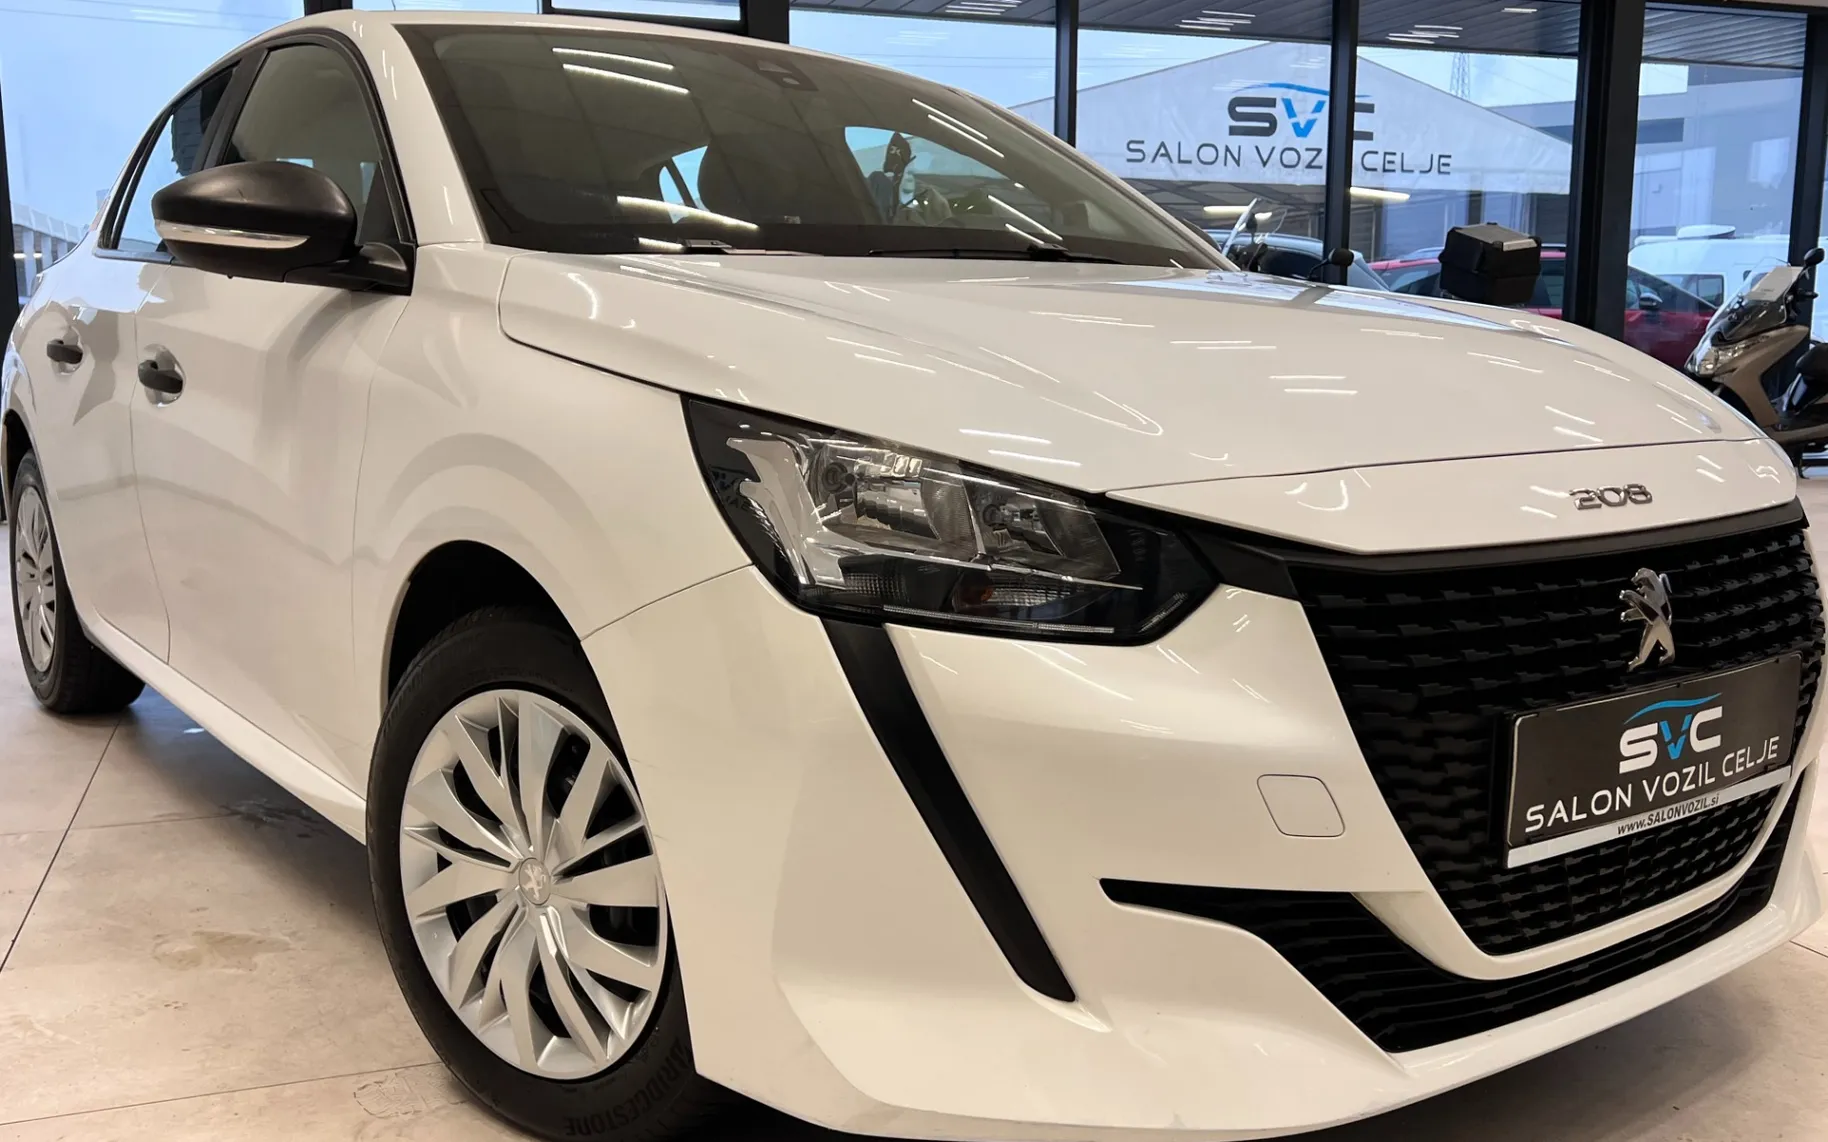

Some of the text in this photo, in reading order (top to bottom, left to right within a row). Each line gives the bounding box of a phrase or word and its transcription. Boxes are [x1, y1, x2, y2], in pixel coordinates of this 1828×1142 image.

[1126, 140, 1452, 175] SALON VOZ CELJE
[1569, 483, 1653, 510] 208
[1619, 706, 1723, 774] SVC
[1525, 736, 1780, 833] SALON VOZIL CELJE
[1617, 793, 1720, 835] www.SALONVOZIL.si
